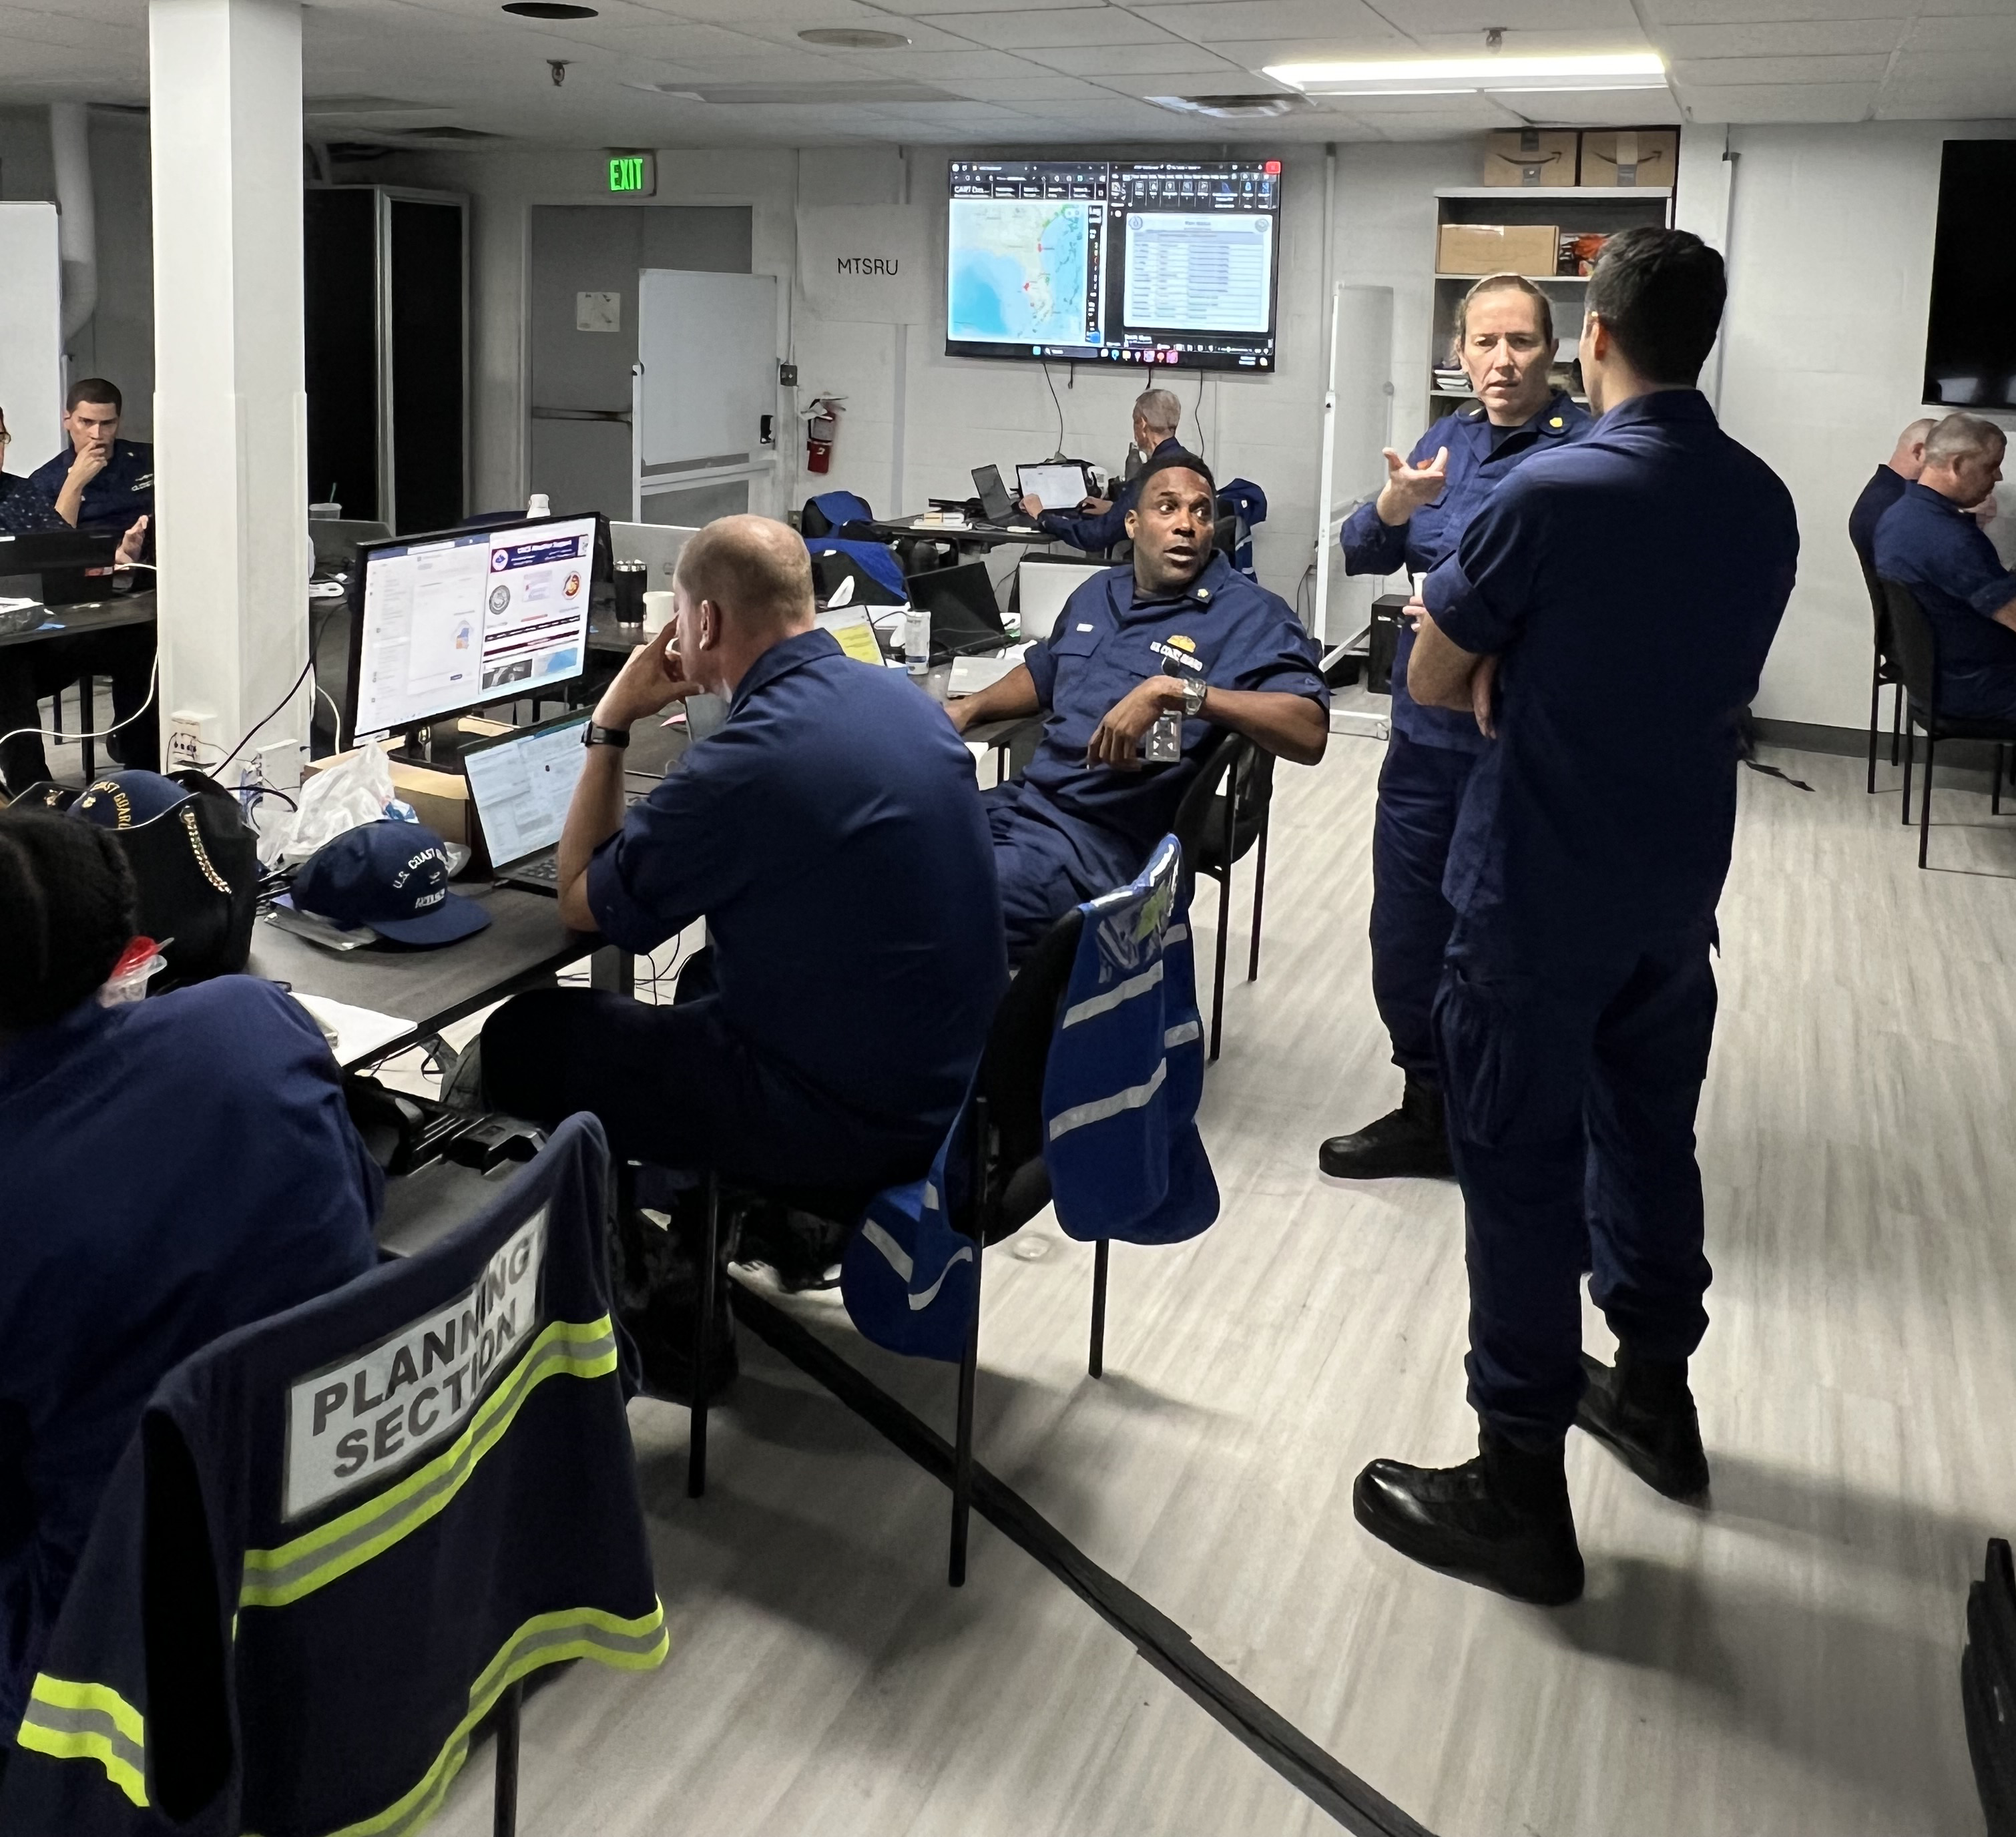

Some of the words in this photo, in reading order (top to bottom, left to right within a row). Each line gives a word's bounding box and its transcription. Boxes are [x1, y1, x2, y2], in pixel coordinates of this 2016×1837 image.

[610, 158, 643, 191] EXIT
[837, 258, 899, 275] MTSRU
[312, 1237, 531, 1436] PLANNING
[334, 1298, 517, 1478] SECTION
